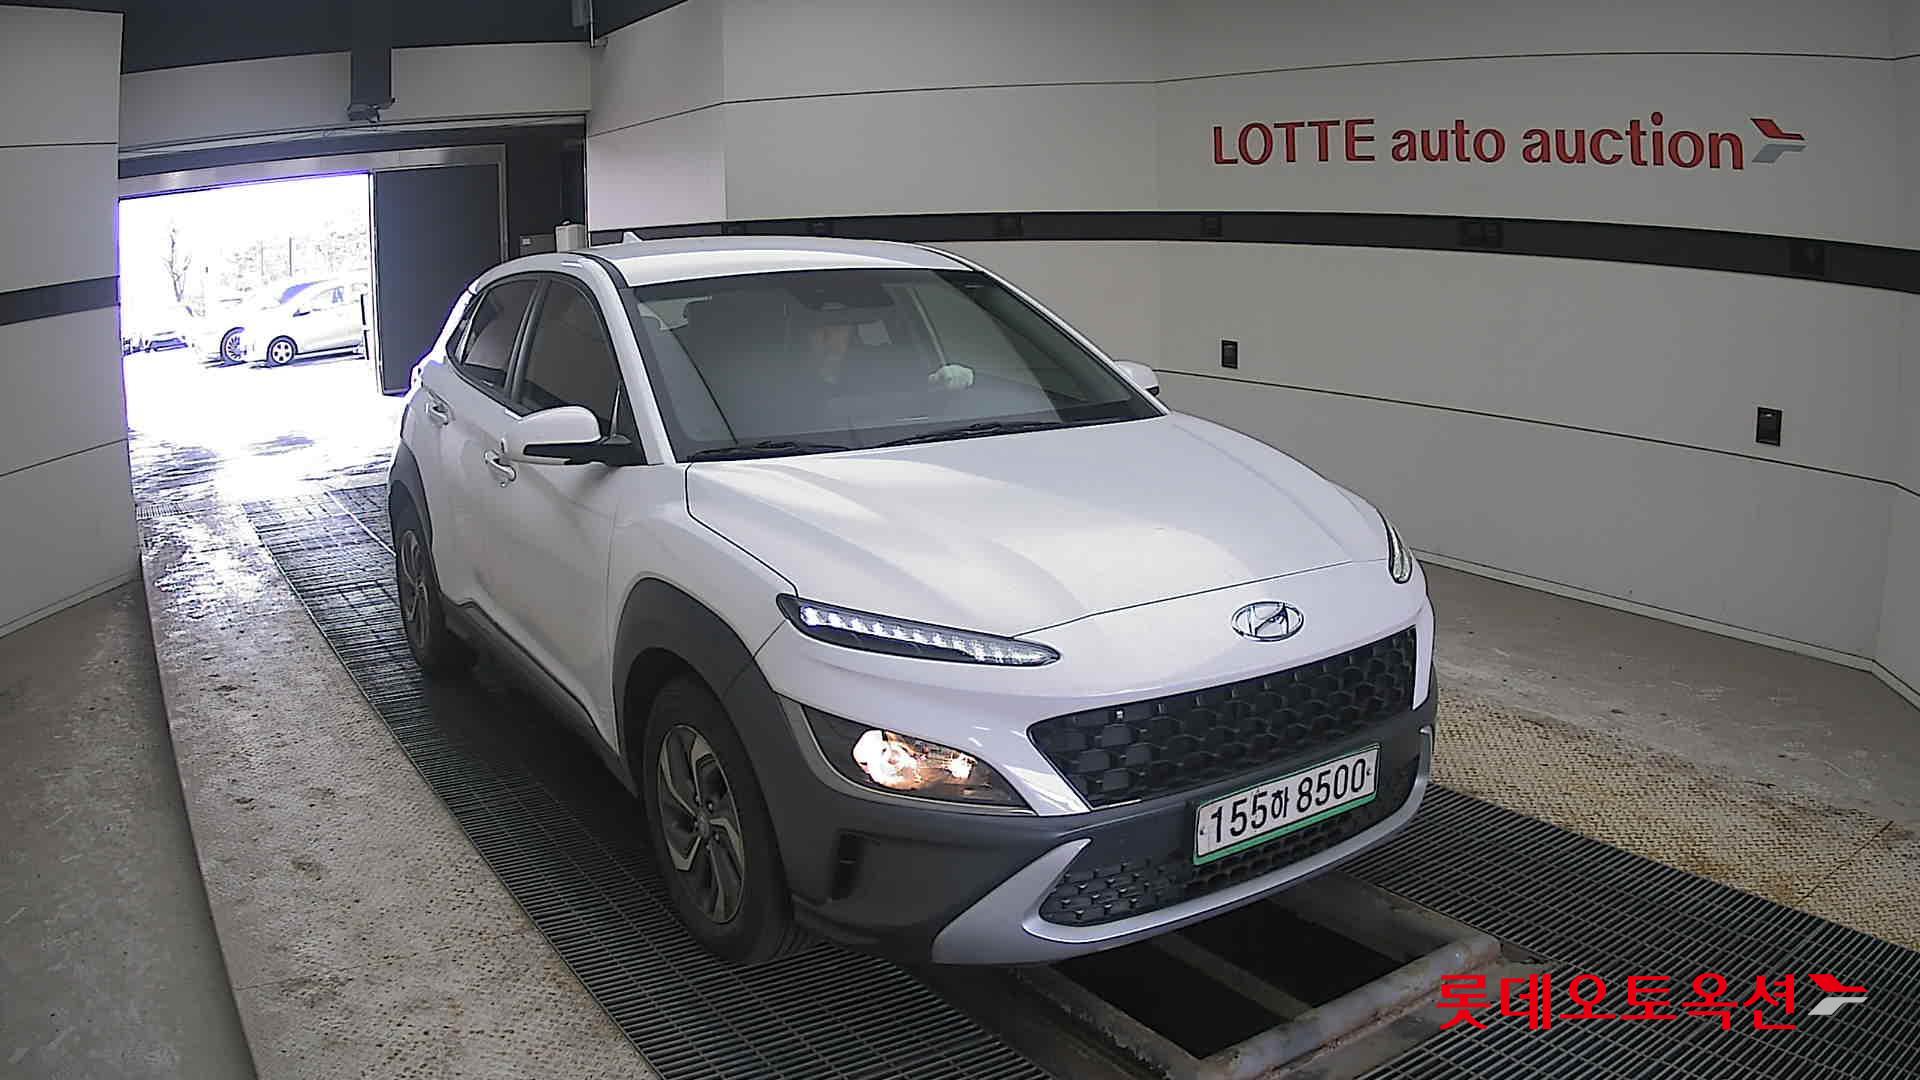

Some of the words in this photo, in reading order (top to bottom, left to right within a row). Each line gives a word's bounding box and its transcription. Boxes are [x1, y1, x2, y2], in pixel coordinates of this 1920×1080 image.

[1212, 118, 1376, 165] LOTTE
[1391, 118, 1505, 162] auto
[1522, 111, 1745, 169] auction
[1296, 758, 1366, 813] 8500
